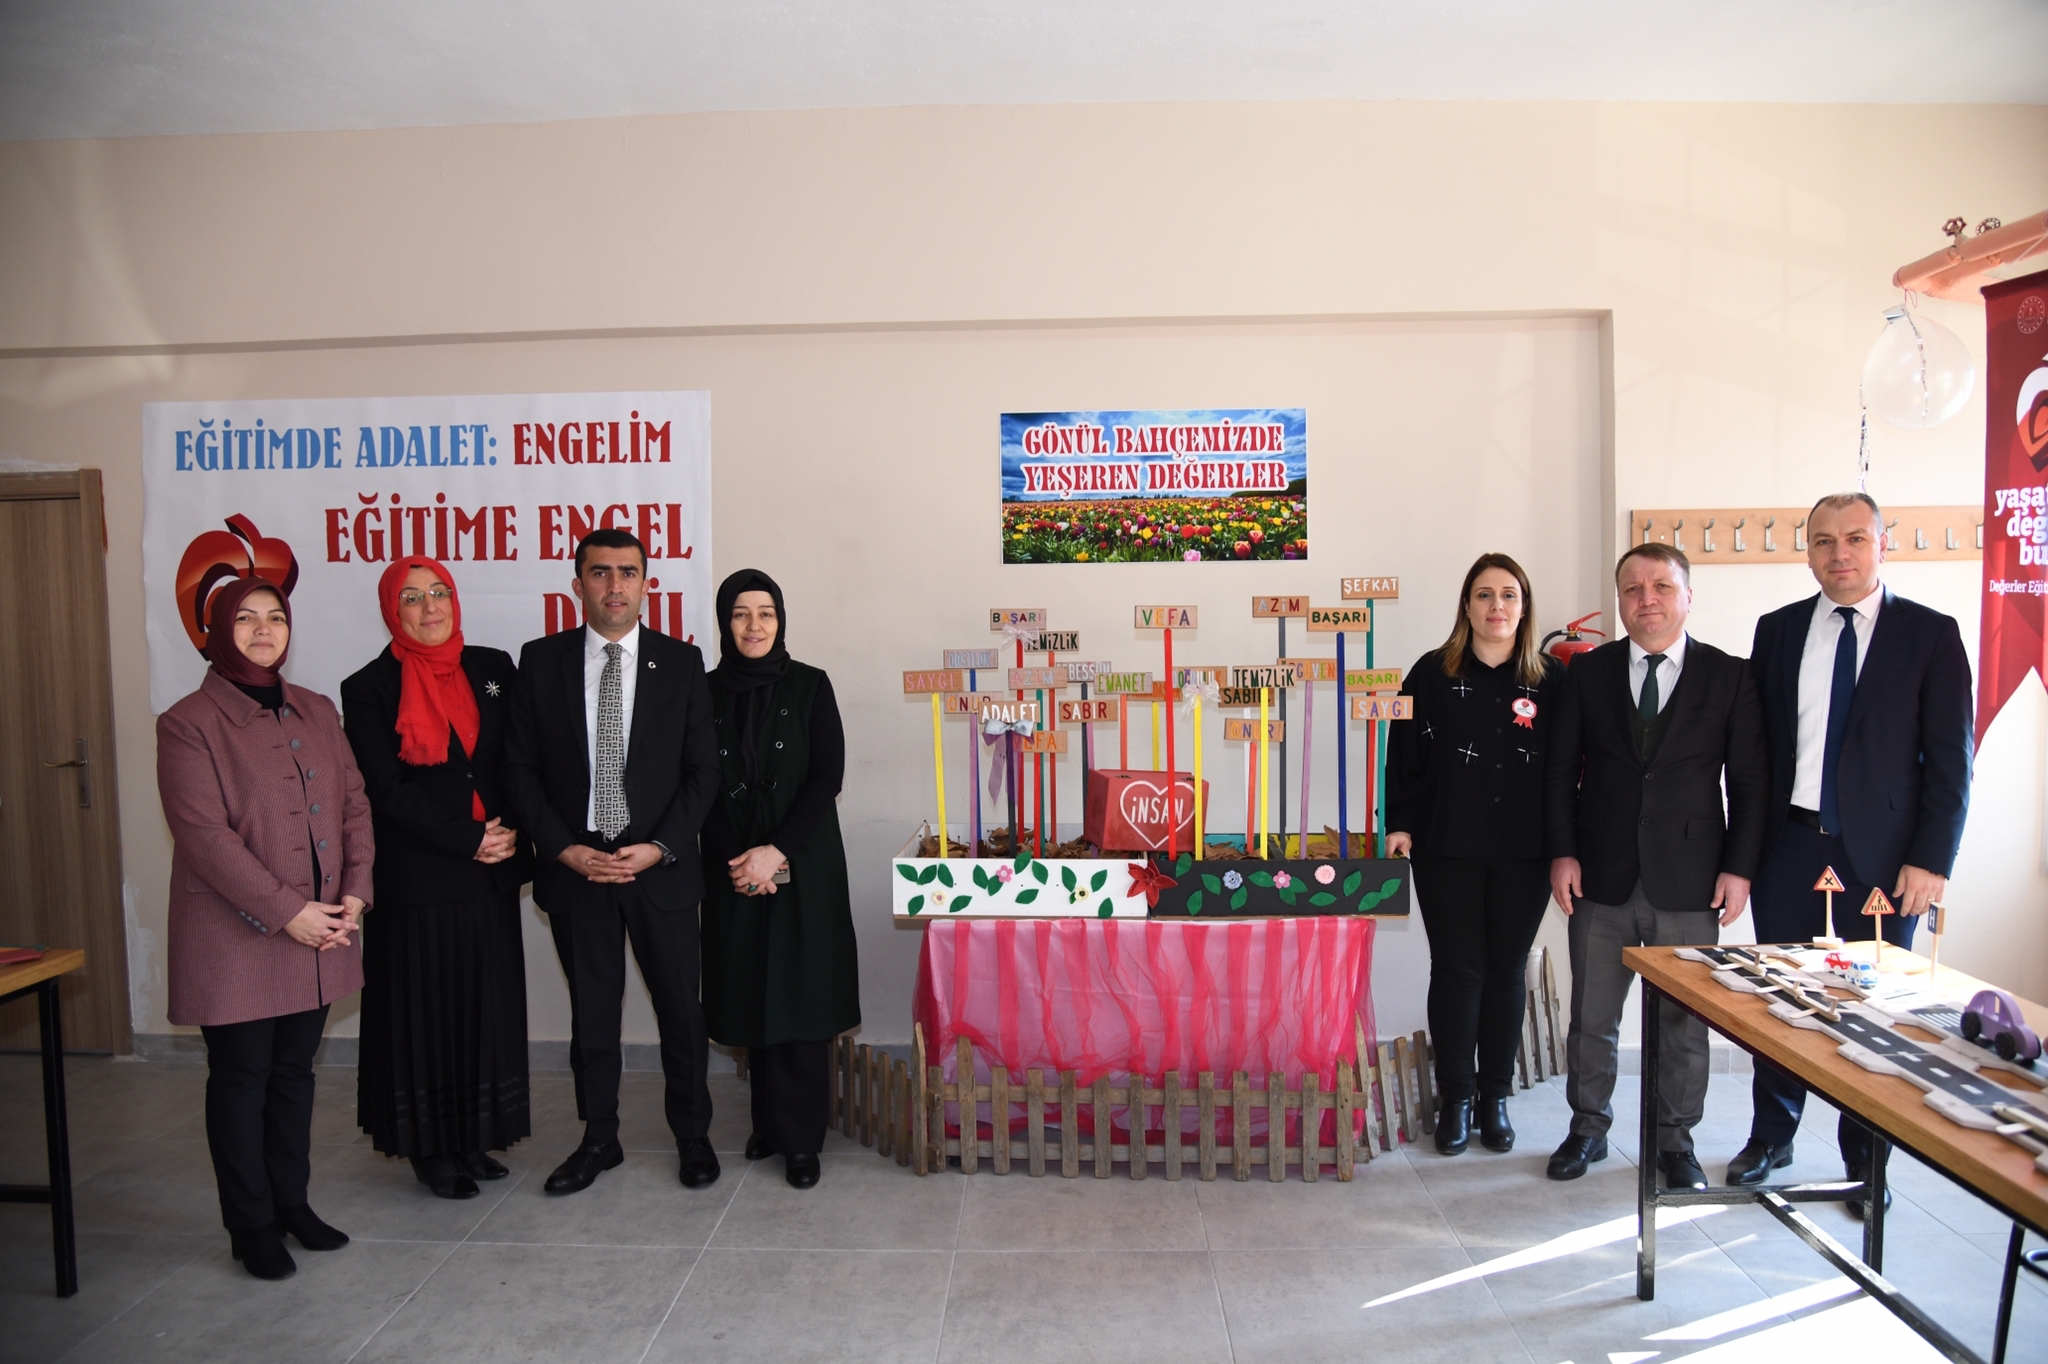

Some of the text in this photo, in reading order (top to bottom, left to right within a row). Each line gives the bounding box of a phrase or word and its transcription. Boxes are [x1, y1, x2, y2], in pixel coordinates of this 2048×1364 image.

[175, 410, 672, 472] EĞİTİMDE ADALET: ENGELİM
[1024, 420, 1283, 458] GÖNÜL BAHÇEMİZDE
[1024, 459, 1287, 497] YEŞEREN DEĞERLER
[325, 492, 519, 564] EĞİTİME
[1344, 577, 1398, 594] ŞEFKAT
[1989, 580, 2027, 596] Değerler
[543, 577, 695, 645] DİL
[992, 612, 1042, 625] BAŞARI
[1142, 608, 1190, 626] VEFA
[1311, 611, 1367, 625] BAŞARI
[906, 673, 955, 692] SAYGI
[1347, 673, 1399, 687] BAŞARI
[1062, 701, 1107, 720] SABIR
[1358, 700, 1409, 718] SAYGI
